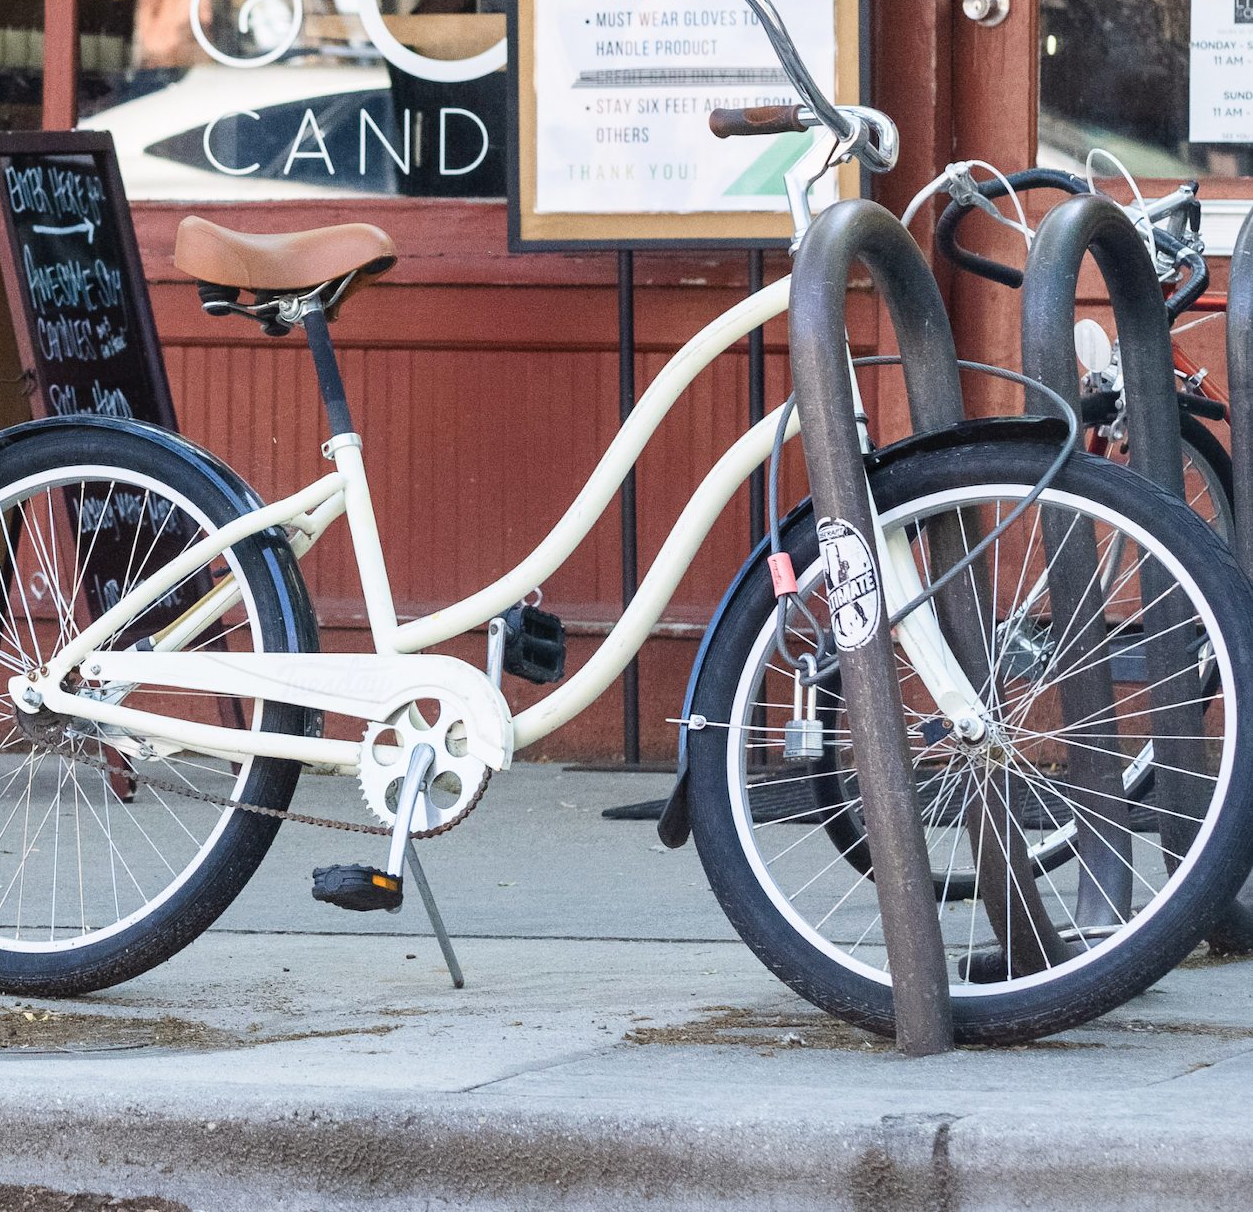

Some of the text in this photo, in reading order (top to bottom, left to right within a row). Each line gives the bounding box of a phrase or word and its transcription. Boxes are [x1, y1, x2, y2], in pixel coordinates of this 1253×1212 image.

[596, 10, 759, 27] MUST WEAR GLOVES TO
[596, 39, 718, 57] HANDLE PRODUCT
[1190, 41, 1237, 51] MONDAY
[1224, 55, 1244, 66] AM
[596, 98, 631, 114] STAY
[637, 98, 660, 114] SIX
[665, 98, 698, 114] FEET
[1224, 107, 1243, 117] AM
[202, 107, 490, 176] CAND
[596, 127, 650, 143] OTHERS
[567, 164, 636, 181] THANK
